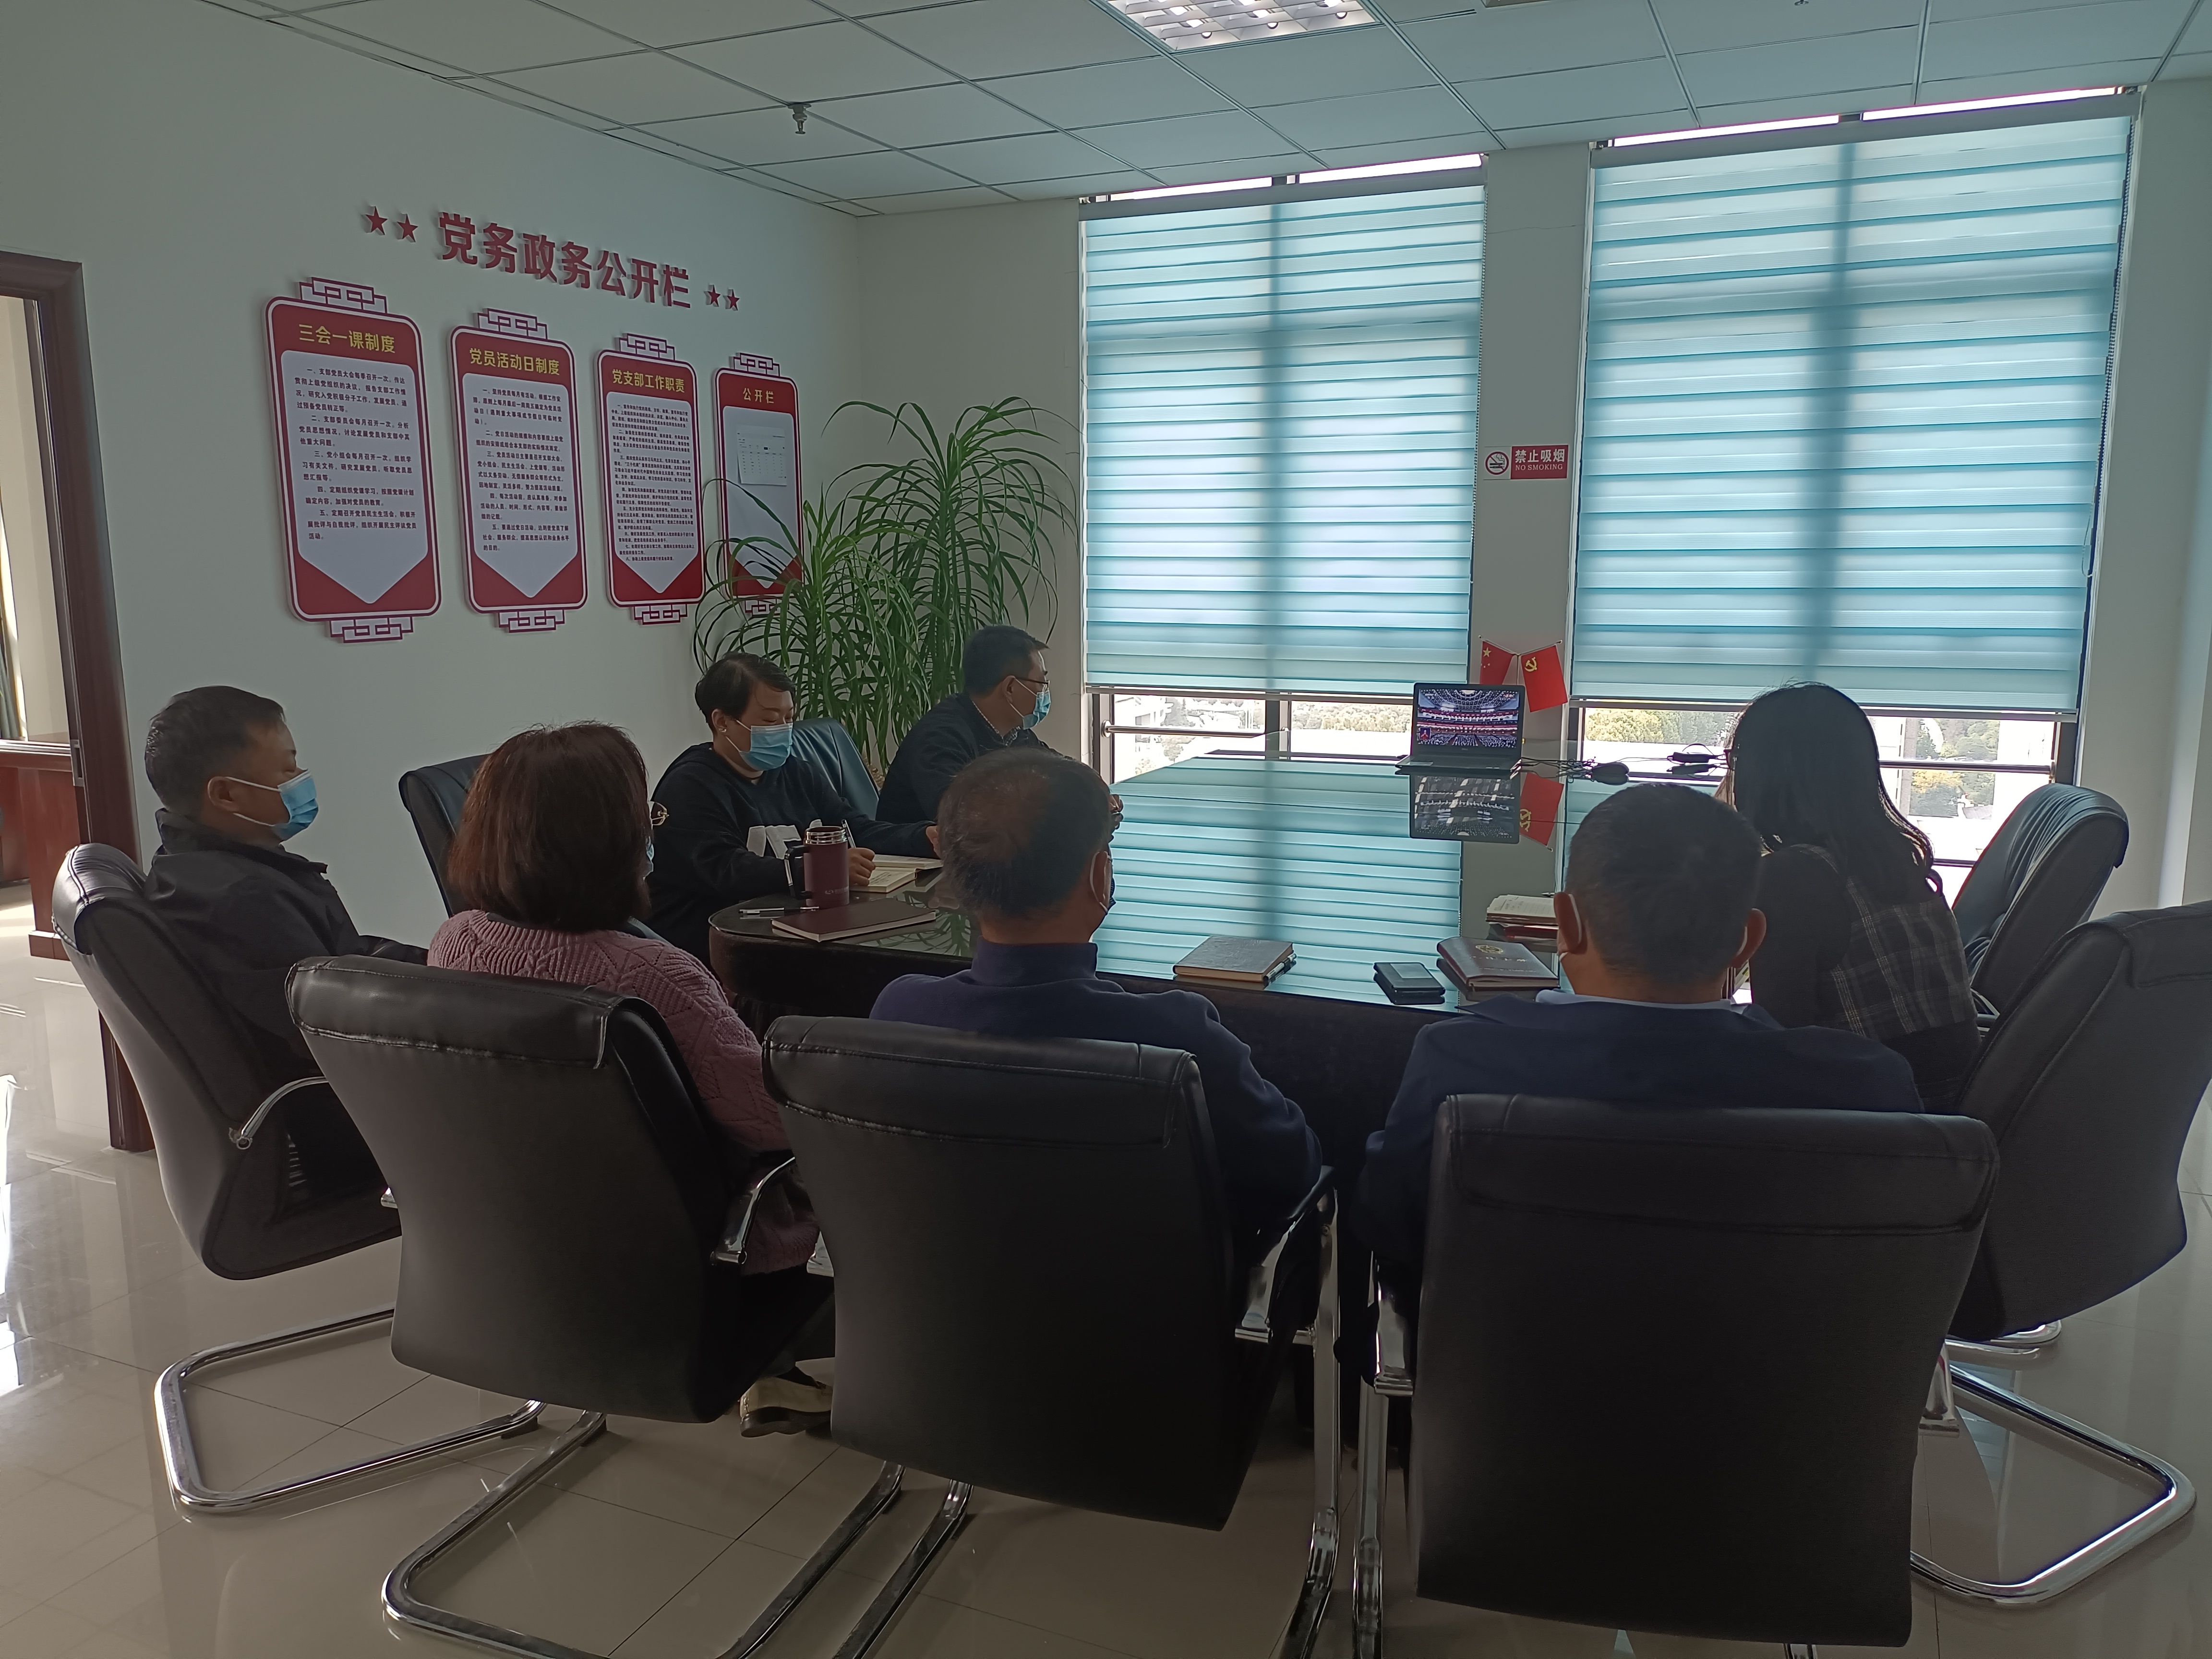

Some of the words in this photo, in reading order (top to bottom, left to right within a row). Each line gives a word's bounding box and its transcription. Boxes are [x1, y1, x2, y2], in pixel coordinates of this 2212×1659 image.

[438, 212, 691, 308] 党务政务公开栏
[298, 324, 396, 353] 三会一课制度
[469, 348, 560, 375] 党员活动日制度
[612, 369, 685, 393] 党支部工作职责
[743, 387, 774, 403] 公开栏
[300, 437, 335, 446] 他重大问题。
[1515, 448, 1565, 463] 禁止吸烟
